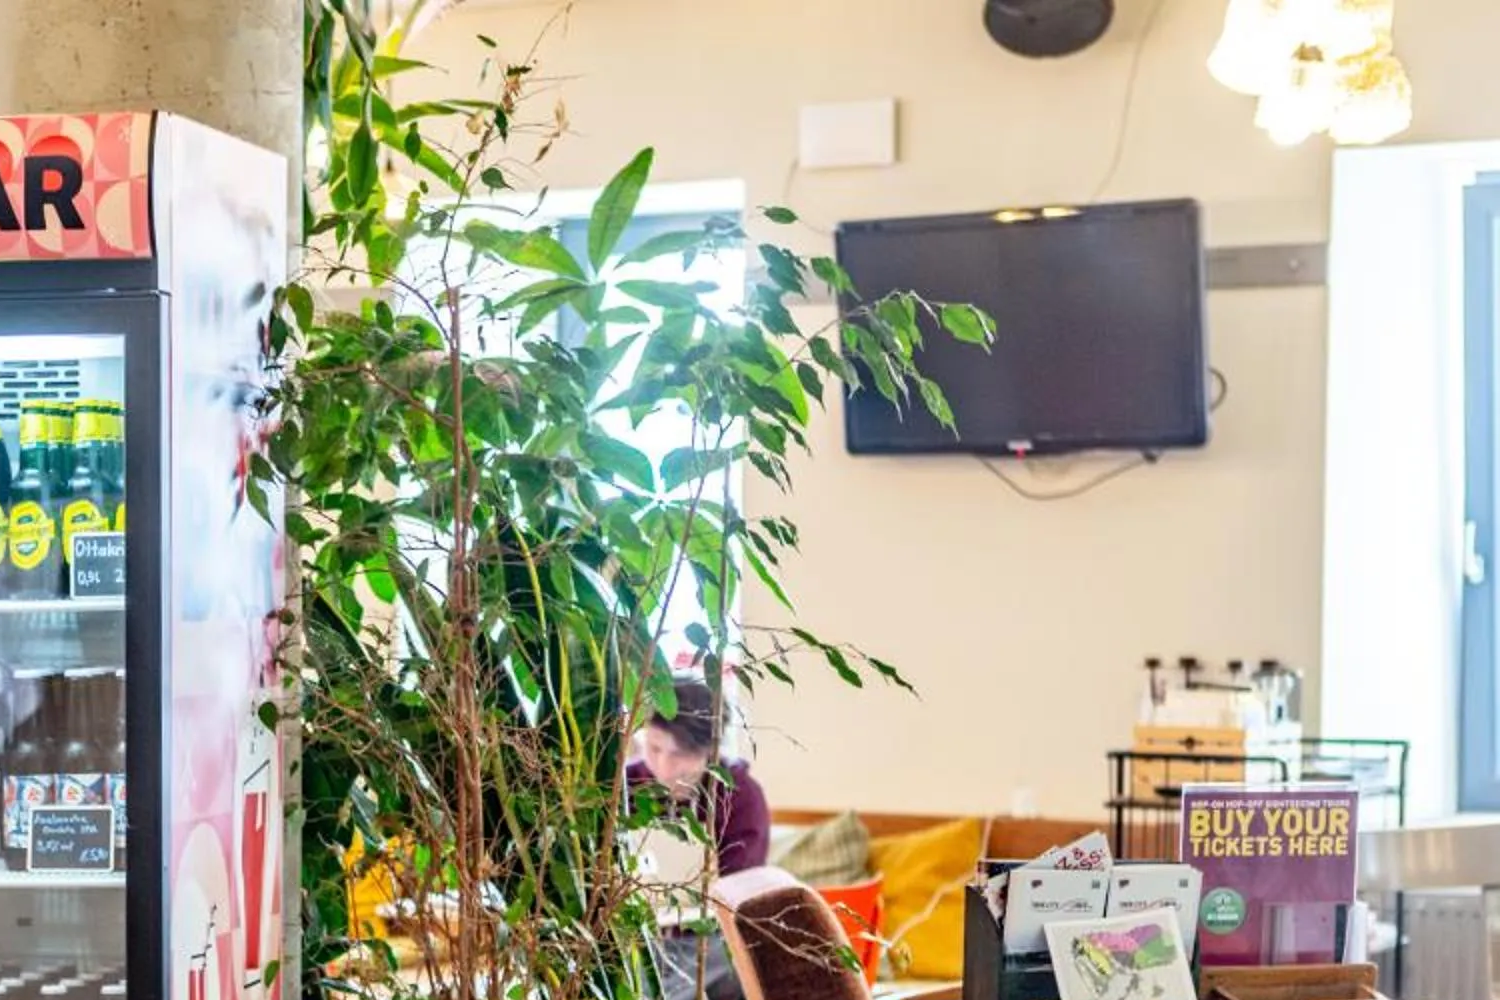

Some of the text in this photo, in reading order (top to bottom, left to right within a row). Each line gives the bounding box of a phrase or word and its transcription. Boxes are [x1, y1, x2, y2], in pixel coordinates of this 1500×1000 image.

[75, 541, 124, 558] Ottakri
[1190, 807, 1350, 837] BUY YOUR
[1190, 836, 1349, 857] TICKETS HERE
